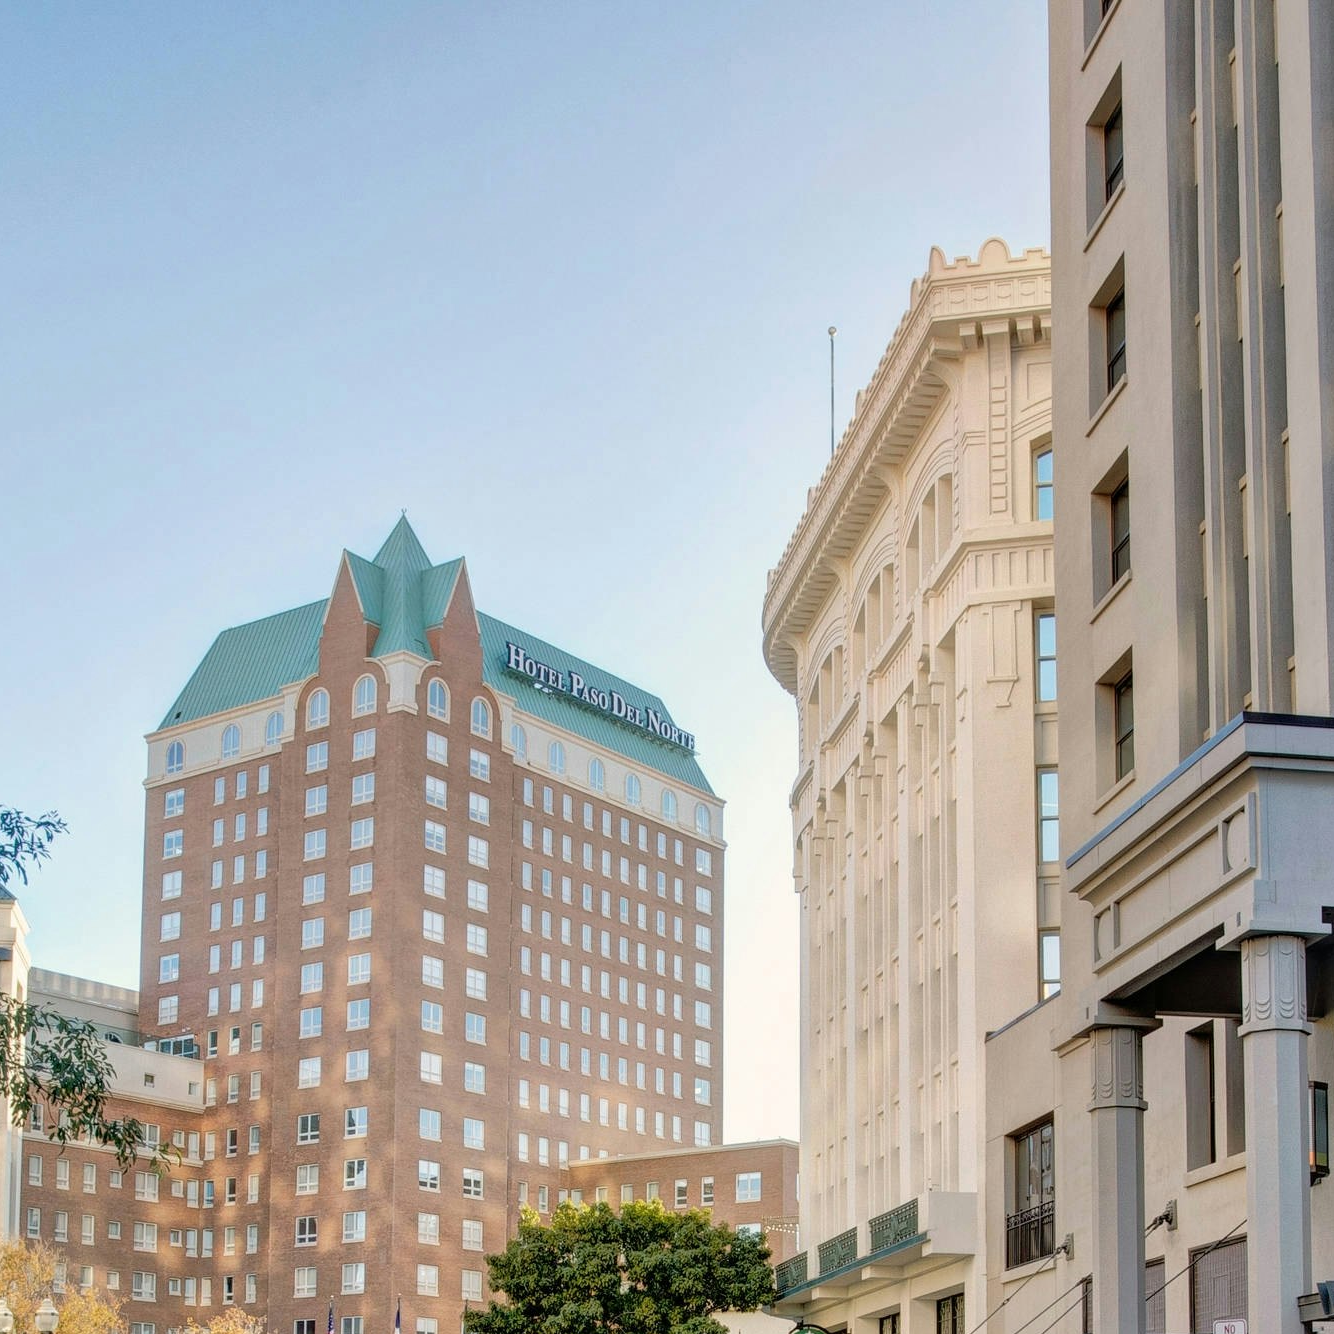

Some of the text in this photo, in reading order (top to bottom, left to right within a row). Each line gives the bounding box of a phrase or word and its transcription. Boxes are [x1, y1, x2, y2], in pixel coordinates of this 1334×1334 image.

[507, 642, 696, 749] HOTEL PASO DEL NORTE
[1224, 1324, 1236, 1334] NO
